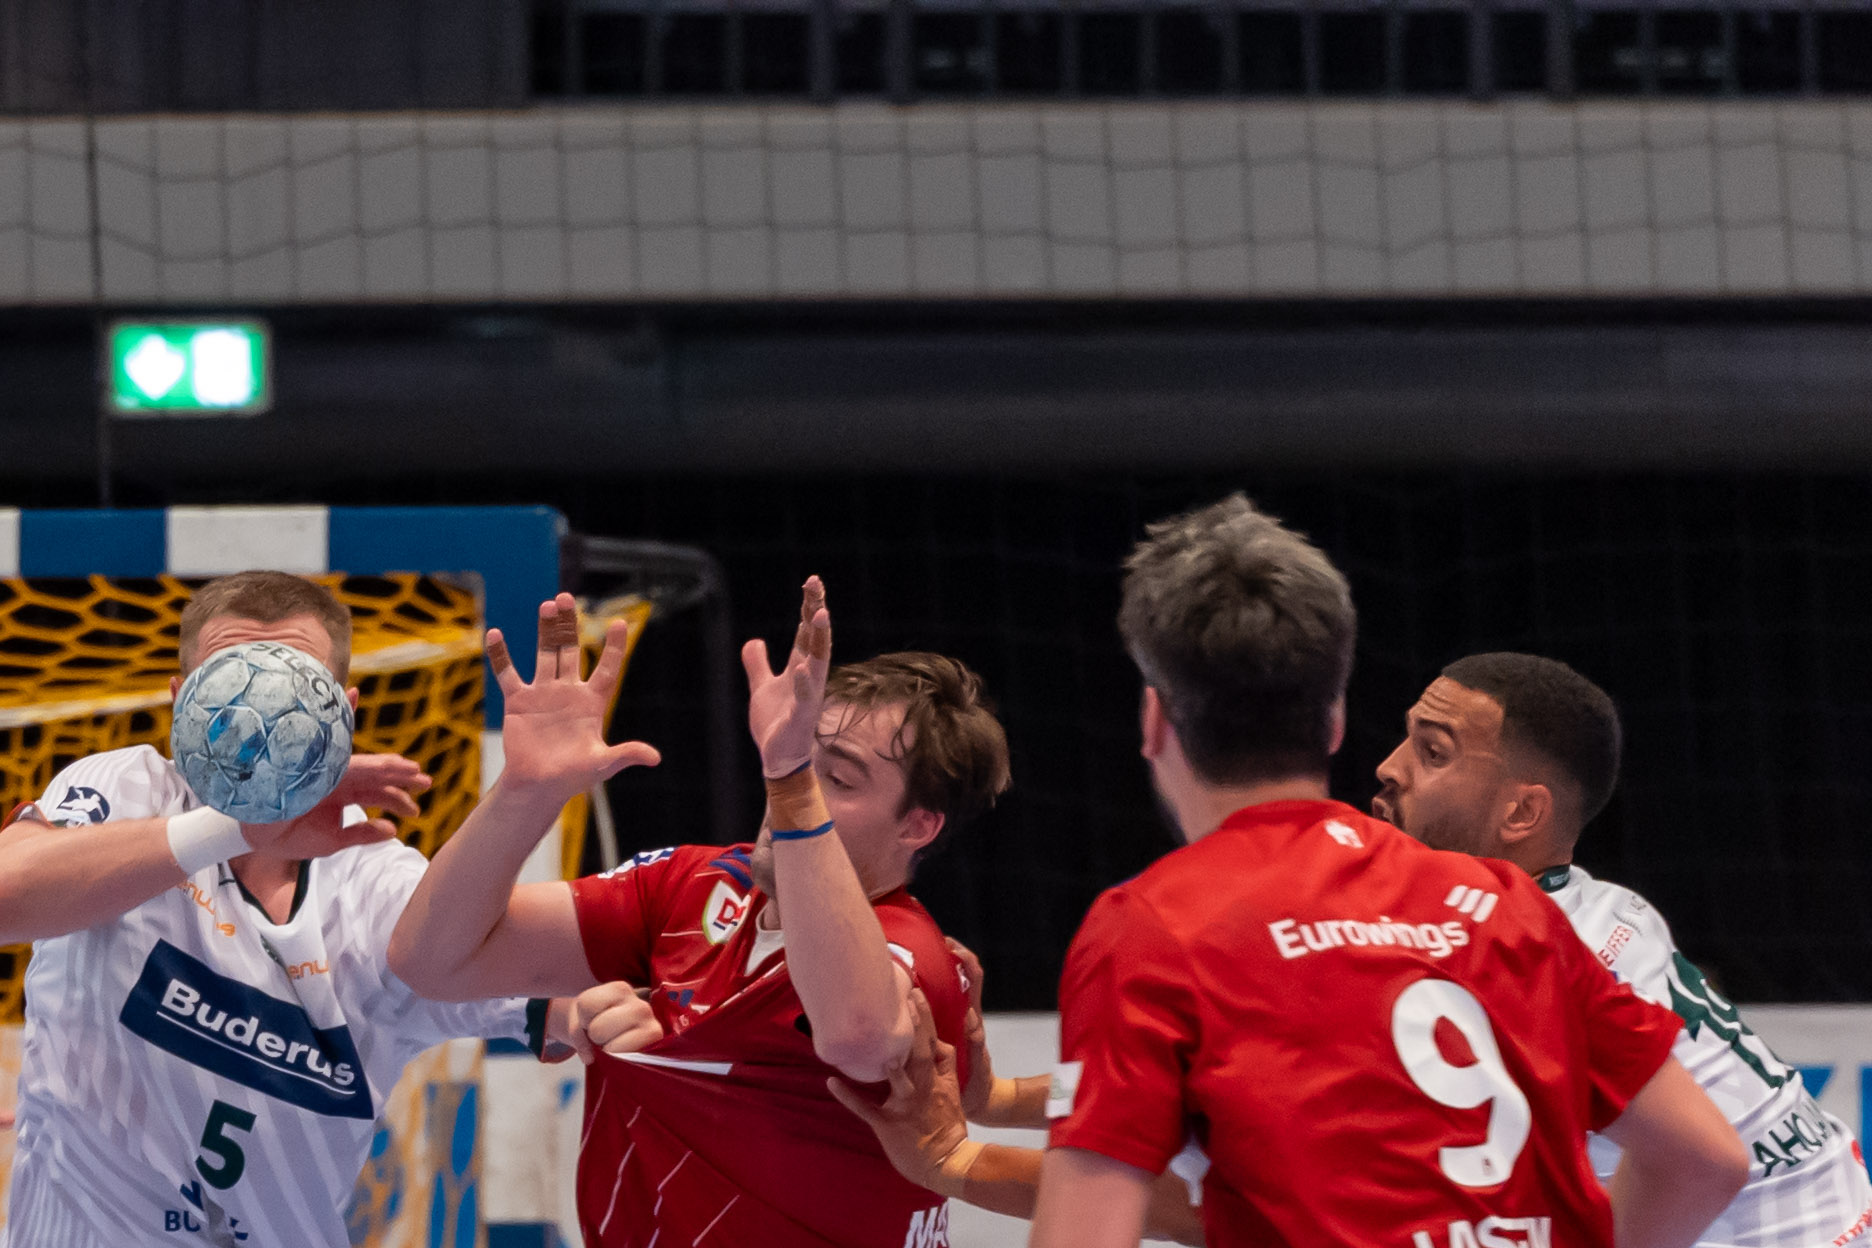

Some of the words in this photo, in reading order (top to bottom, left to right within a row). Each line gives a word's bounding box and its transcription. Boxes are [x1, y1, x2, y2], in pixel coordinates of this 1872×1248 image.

[251, 643, 340, 712] SELECT
[1268, 915, 1471, 959] Eurowings
[160, 978, 357, 1087] Buderus
[1390, 977, 1532, 1188] 9
[194, 1098, 258, 1190] 5
